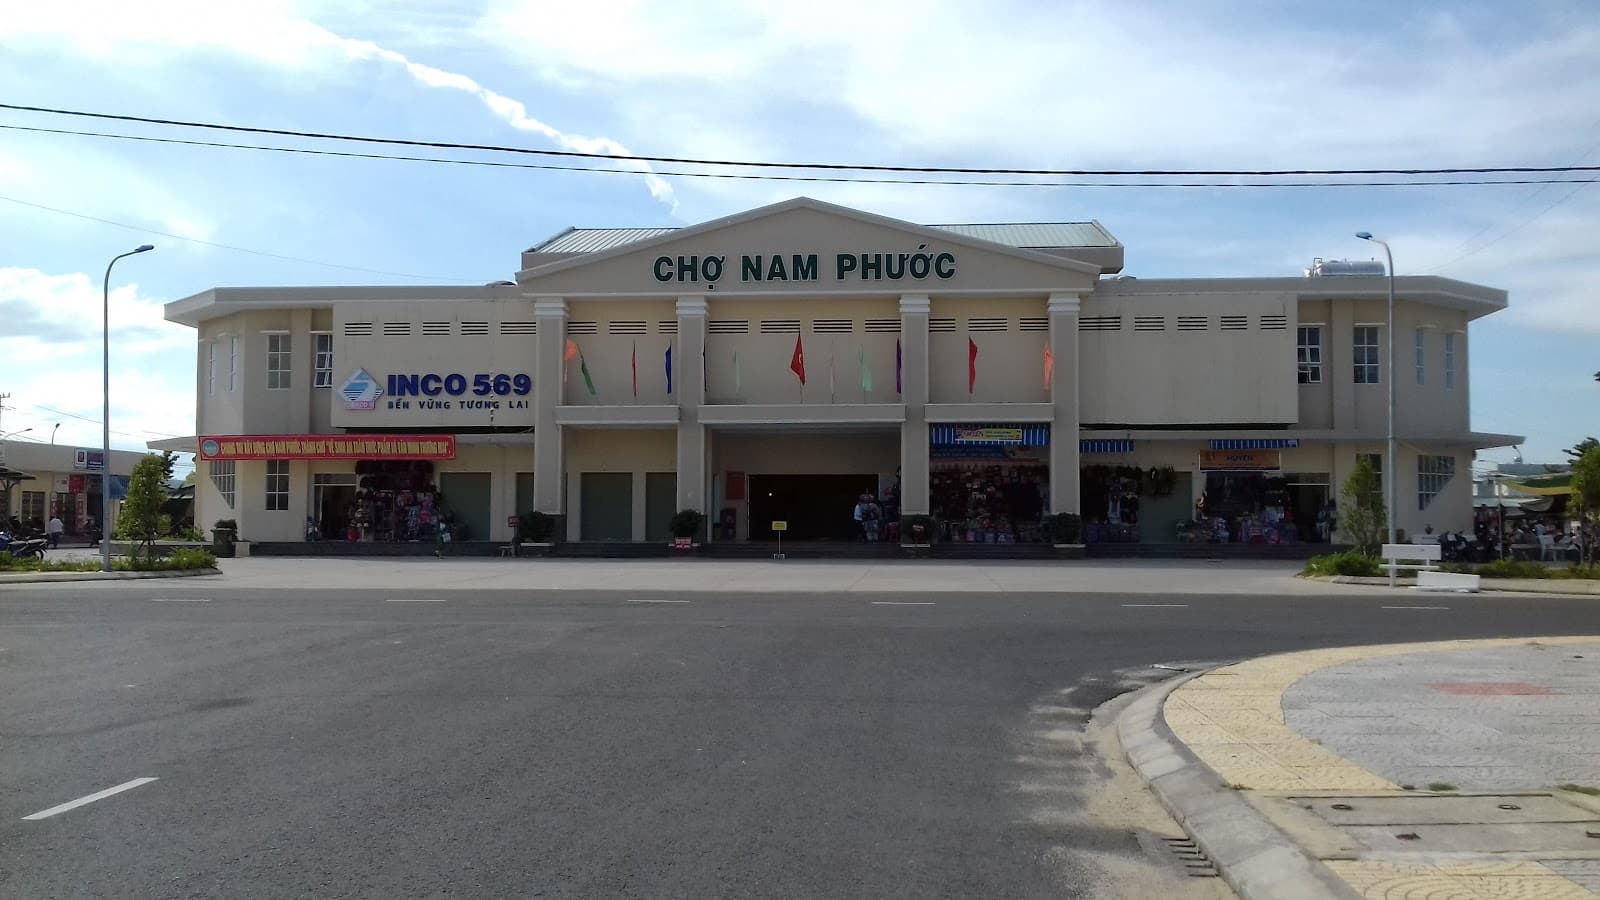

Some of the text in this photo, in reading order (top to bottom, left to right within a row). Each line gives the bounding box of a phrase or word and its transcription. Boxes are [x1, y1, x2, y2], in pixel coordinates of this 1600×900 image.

[653, 243, 957, 290] CHỢ NAM PHƯỚC
[387, 374, 532, 396] INCO 569
[459, 399, 500, 410] TƯƠNG
[509, 400, 529, 410] LAI
